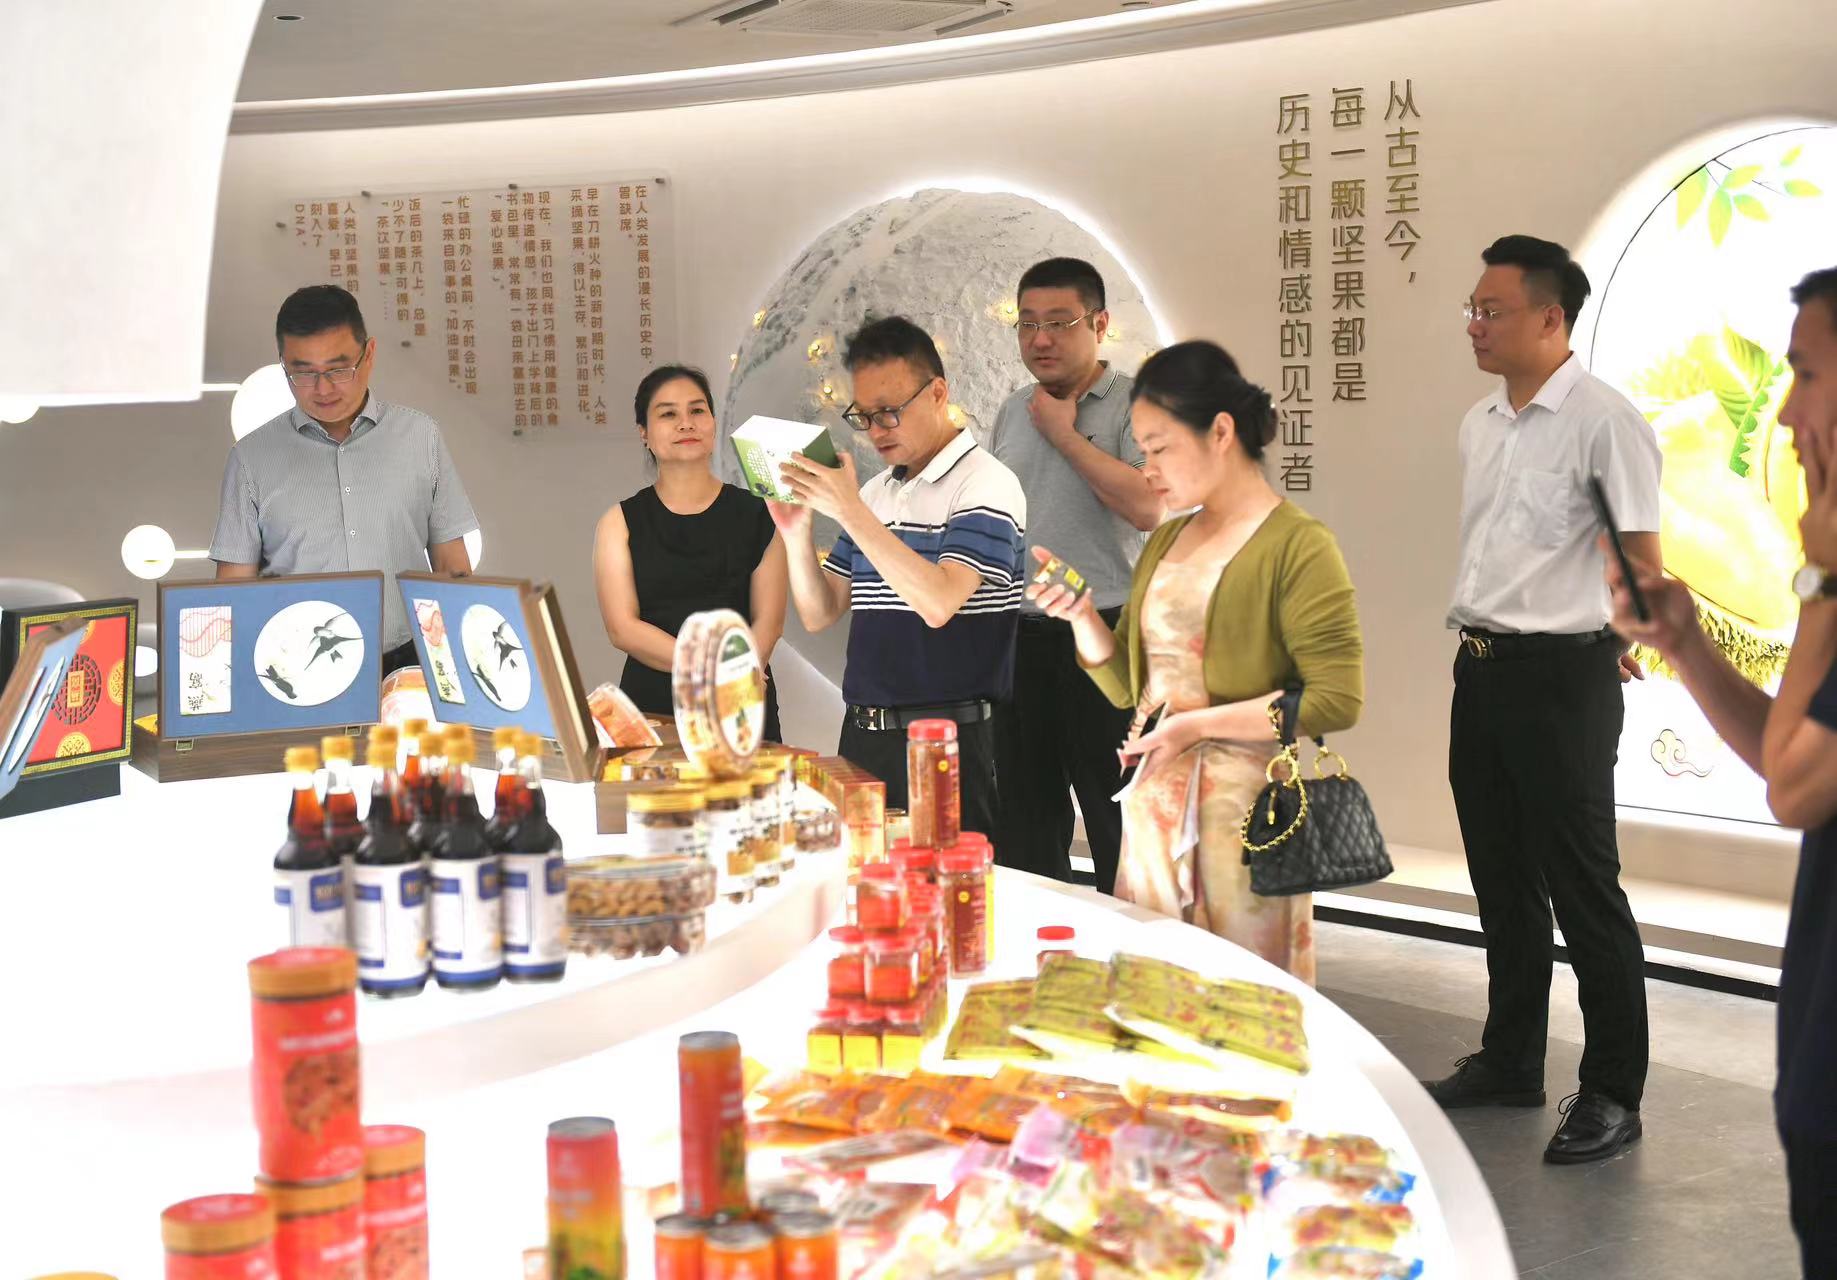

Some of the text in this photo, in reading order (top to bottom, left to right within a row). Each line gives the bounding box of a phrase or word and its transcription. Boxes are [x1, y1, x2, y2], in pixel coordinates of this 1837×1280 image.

[311, 203, 323, 247] 刻入了
[344, 202, 359, 292] 人类对坚果的
[1330, 87, 1367, 401] 每一颗坚果都是
[1384, 79, 1421, 283] 从古至今，
[1277, 93, 1314, 492] 历史和情感的见证者
